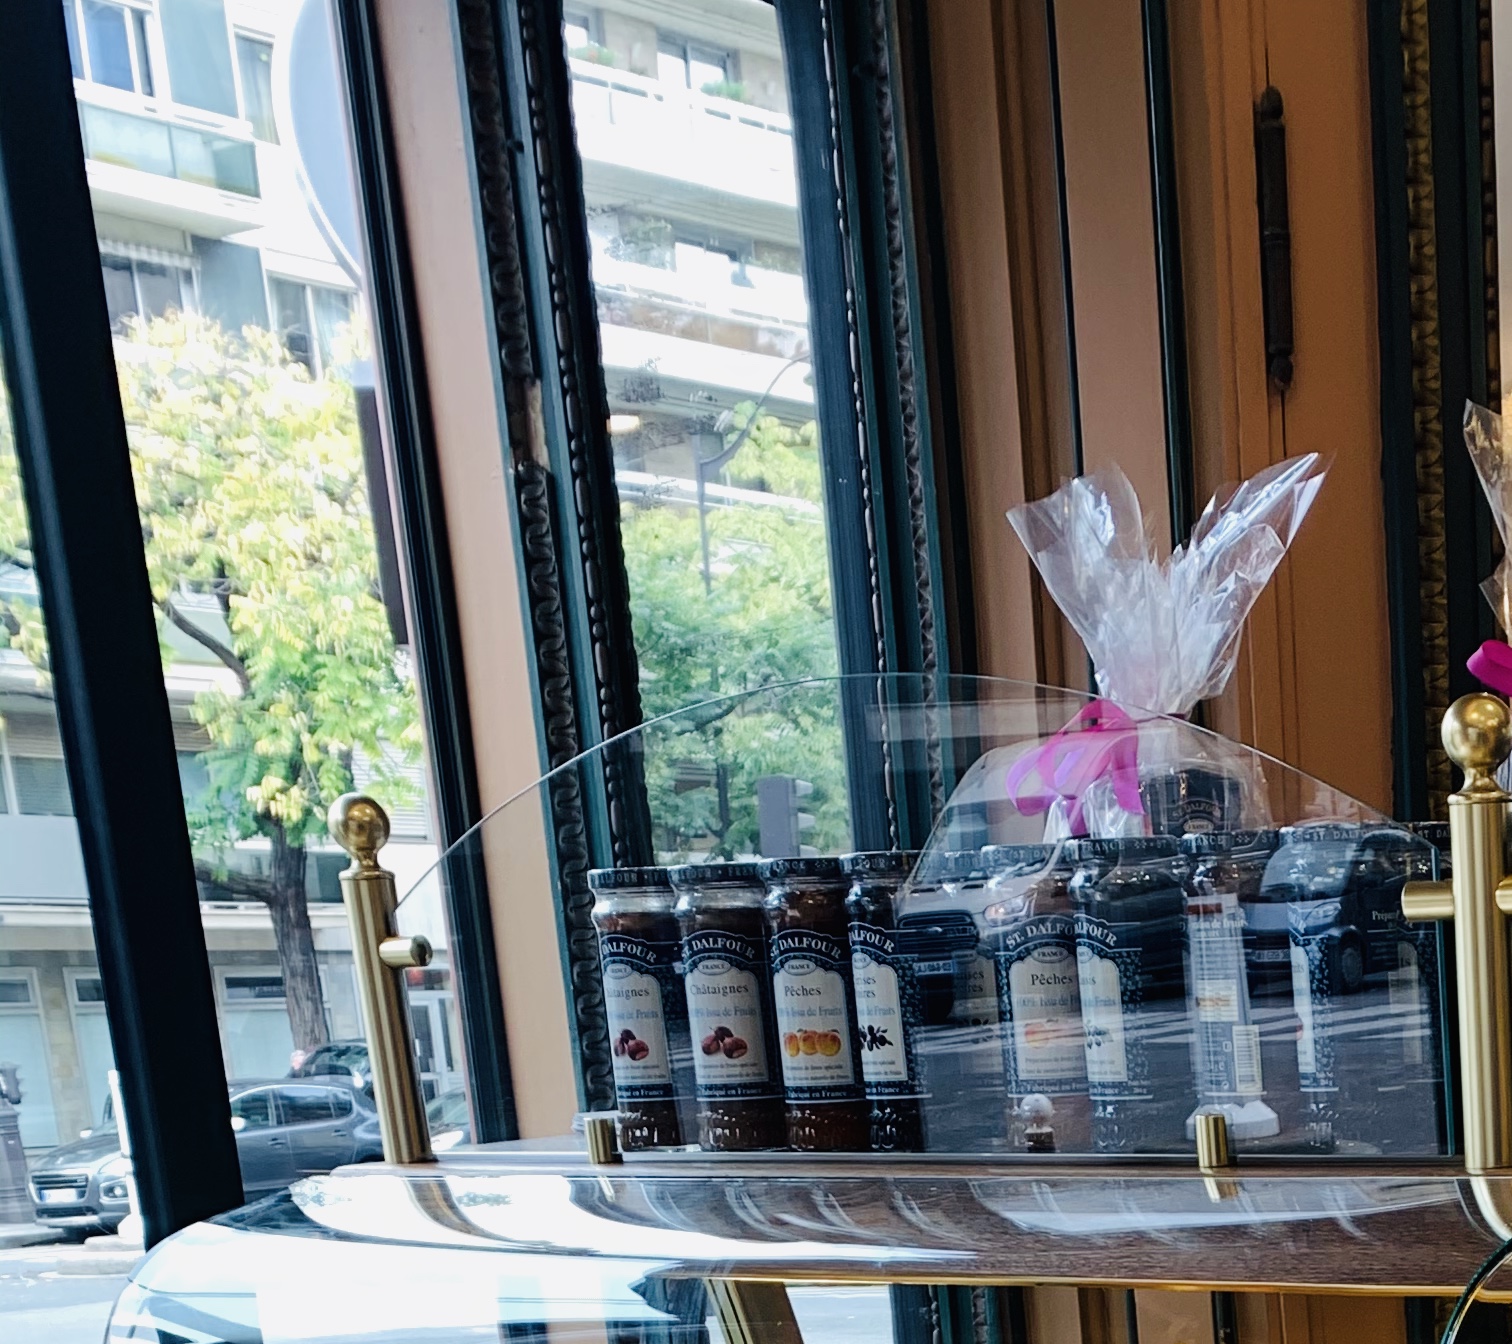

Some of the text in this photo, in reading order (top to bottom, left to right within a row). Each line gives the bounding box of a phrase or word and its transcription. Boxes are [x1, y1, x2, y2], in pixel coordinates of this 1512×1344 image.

[849, 928, 895, 953] ALFOUR
[1006, 921, 1077, 950] ST. DALFO
[692, 937, 755, 960] DALFOUR
[779, 936, 842, 959] DALFOUR
[690, 983, 749, 998] Châtaignes
[784, 984, 822, 997] Pêches
[1031, 972, 1073, 987] Pêches
